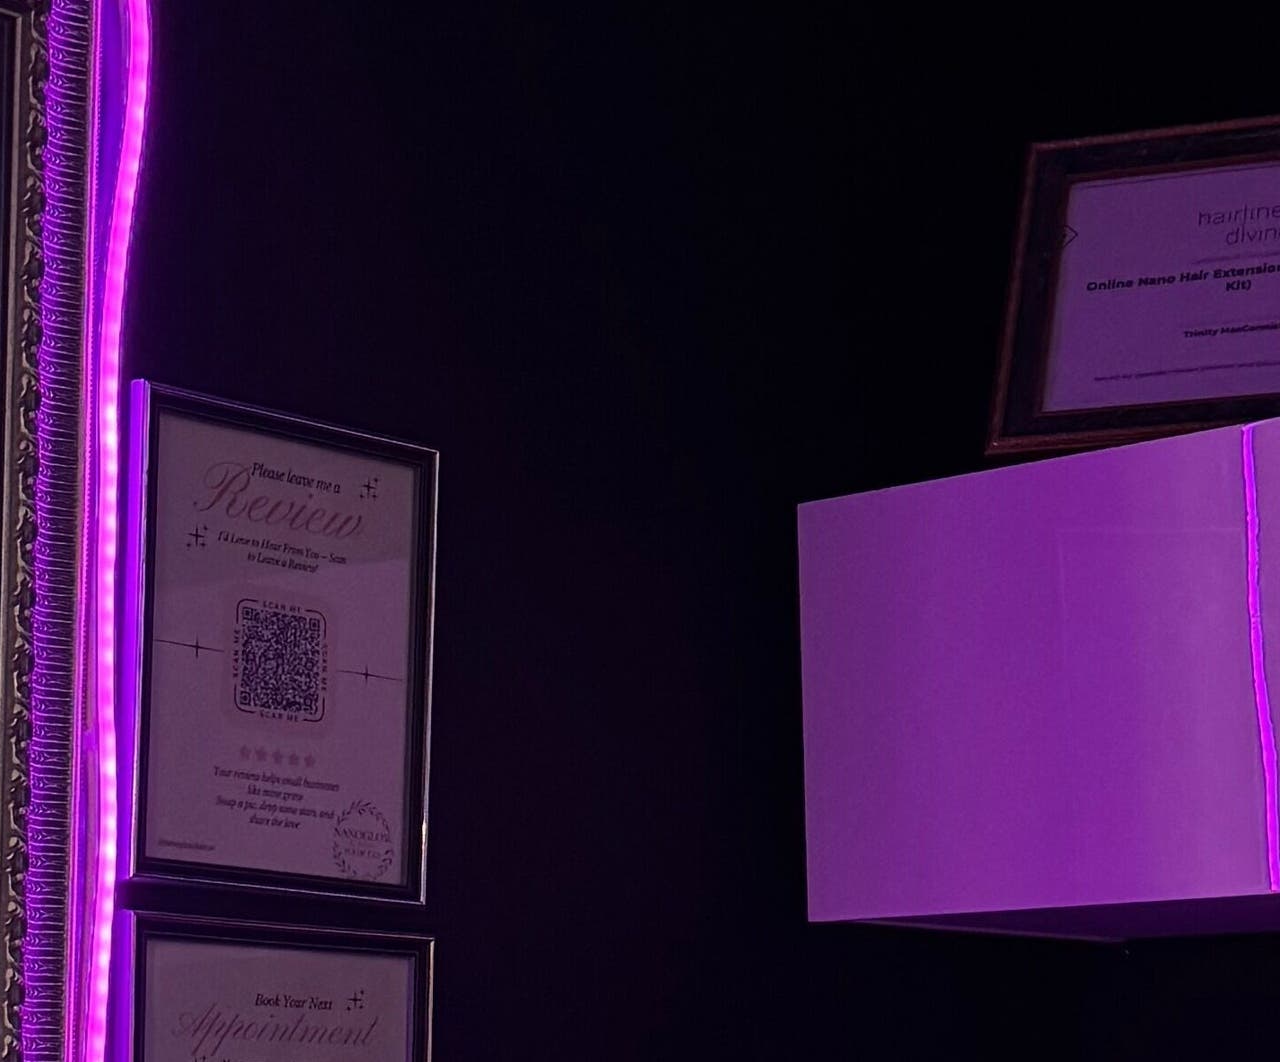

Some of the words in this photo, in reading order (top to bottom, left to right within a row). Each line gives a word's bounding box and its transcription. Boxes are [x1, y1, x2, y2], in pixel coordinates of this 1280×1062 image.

[1086, 278, 1133, 292] Online
[1137, 275, 1176, 287] Nano
[1179, 271, 1210, 282] Hair
[1225, 279, 1252, 292] Kit)
[1183, 328, 1218, 338] Trinity
[251, 461, 285, 482] Please
[286, 467, 315, 488] leave
[316, 479, 332, 491] me
[333, 483, 341, 494] a
[192, 461, 363, 538] Review
[254, 993, 281, 1008] Book
[282, 994, 308, 1009] Your
[308, 996, 333, 1011] Next
[171, 1002, 379, 1057] Appointment
